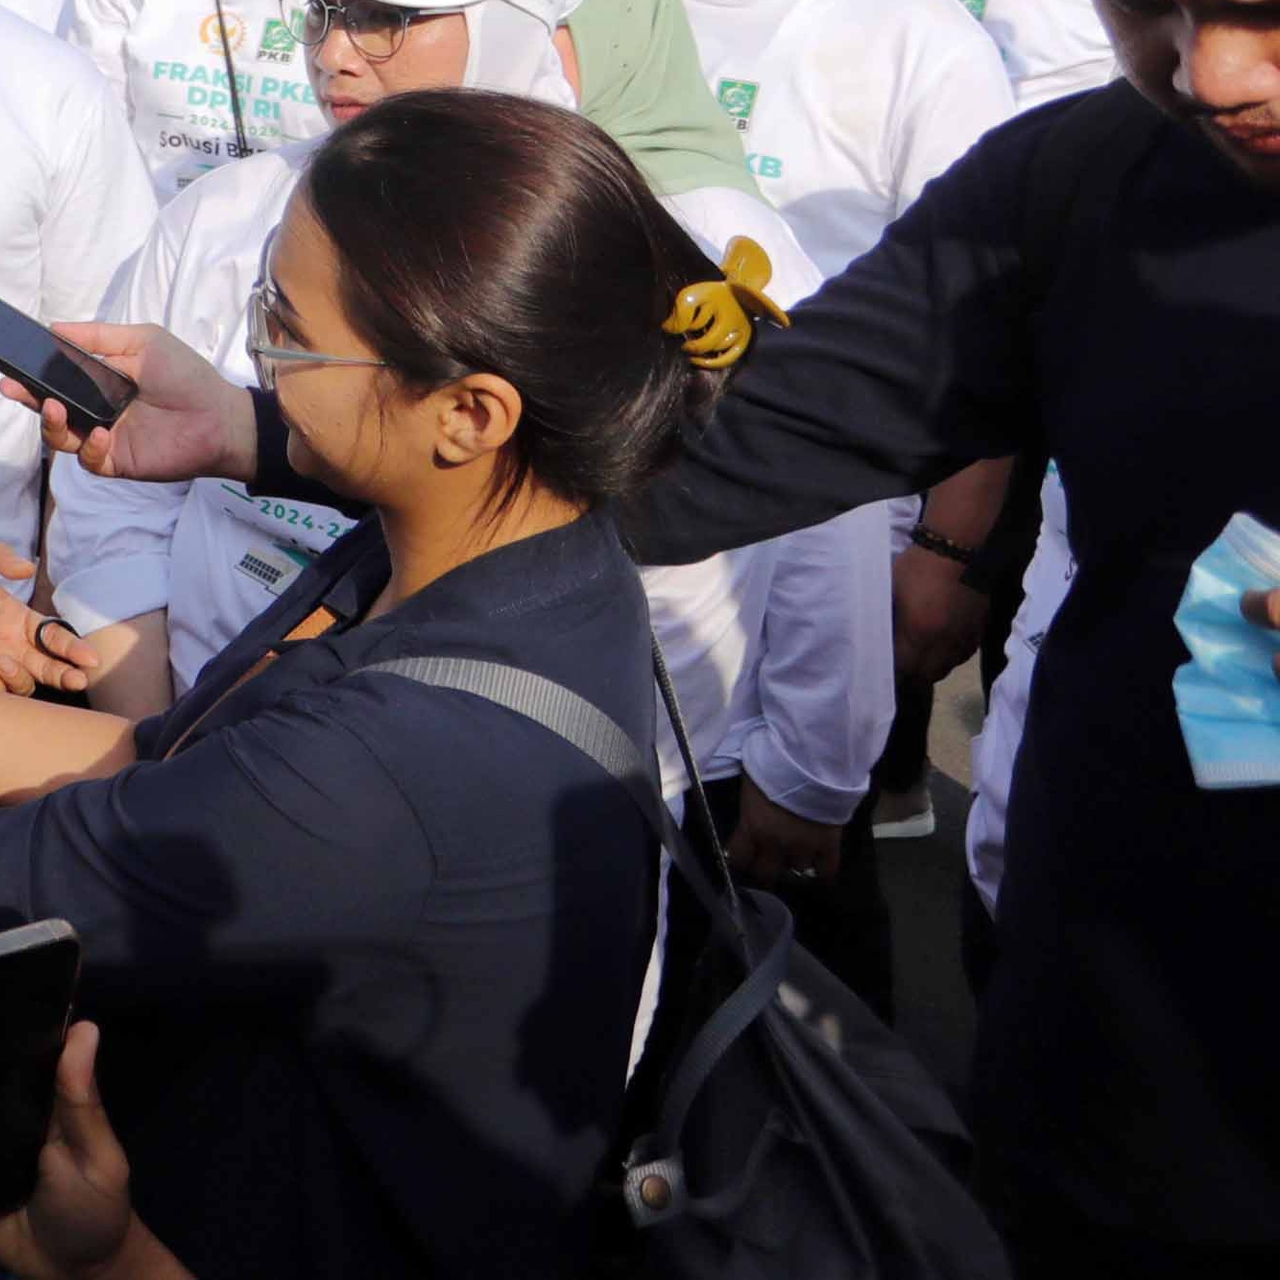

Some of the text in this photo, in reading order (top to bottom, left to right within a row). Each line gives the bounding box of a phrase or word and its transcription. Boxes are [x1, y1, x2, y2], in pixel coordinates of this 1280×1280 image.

[256, 50, 292, 62] PKB
[253, 99, 281, 120] RI
[159, 130, 221, 155] Solusi
[260, 500, 352, 539] 2024-2
